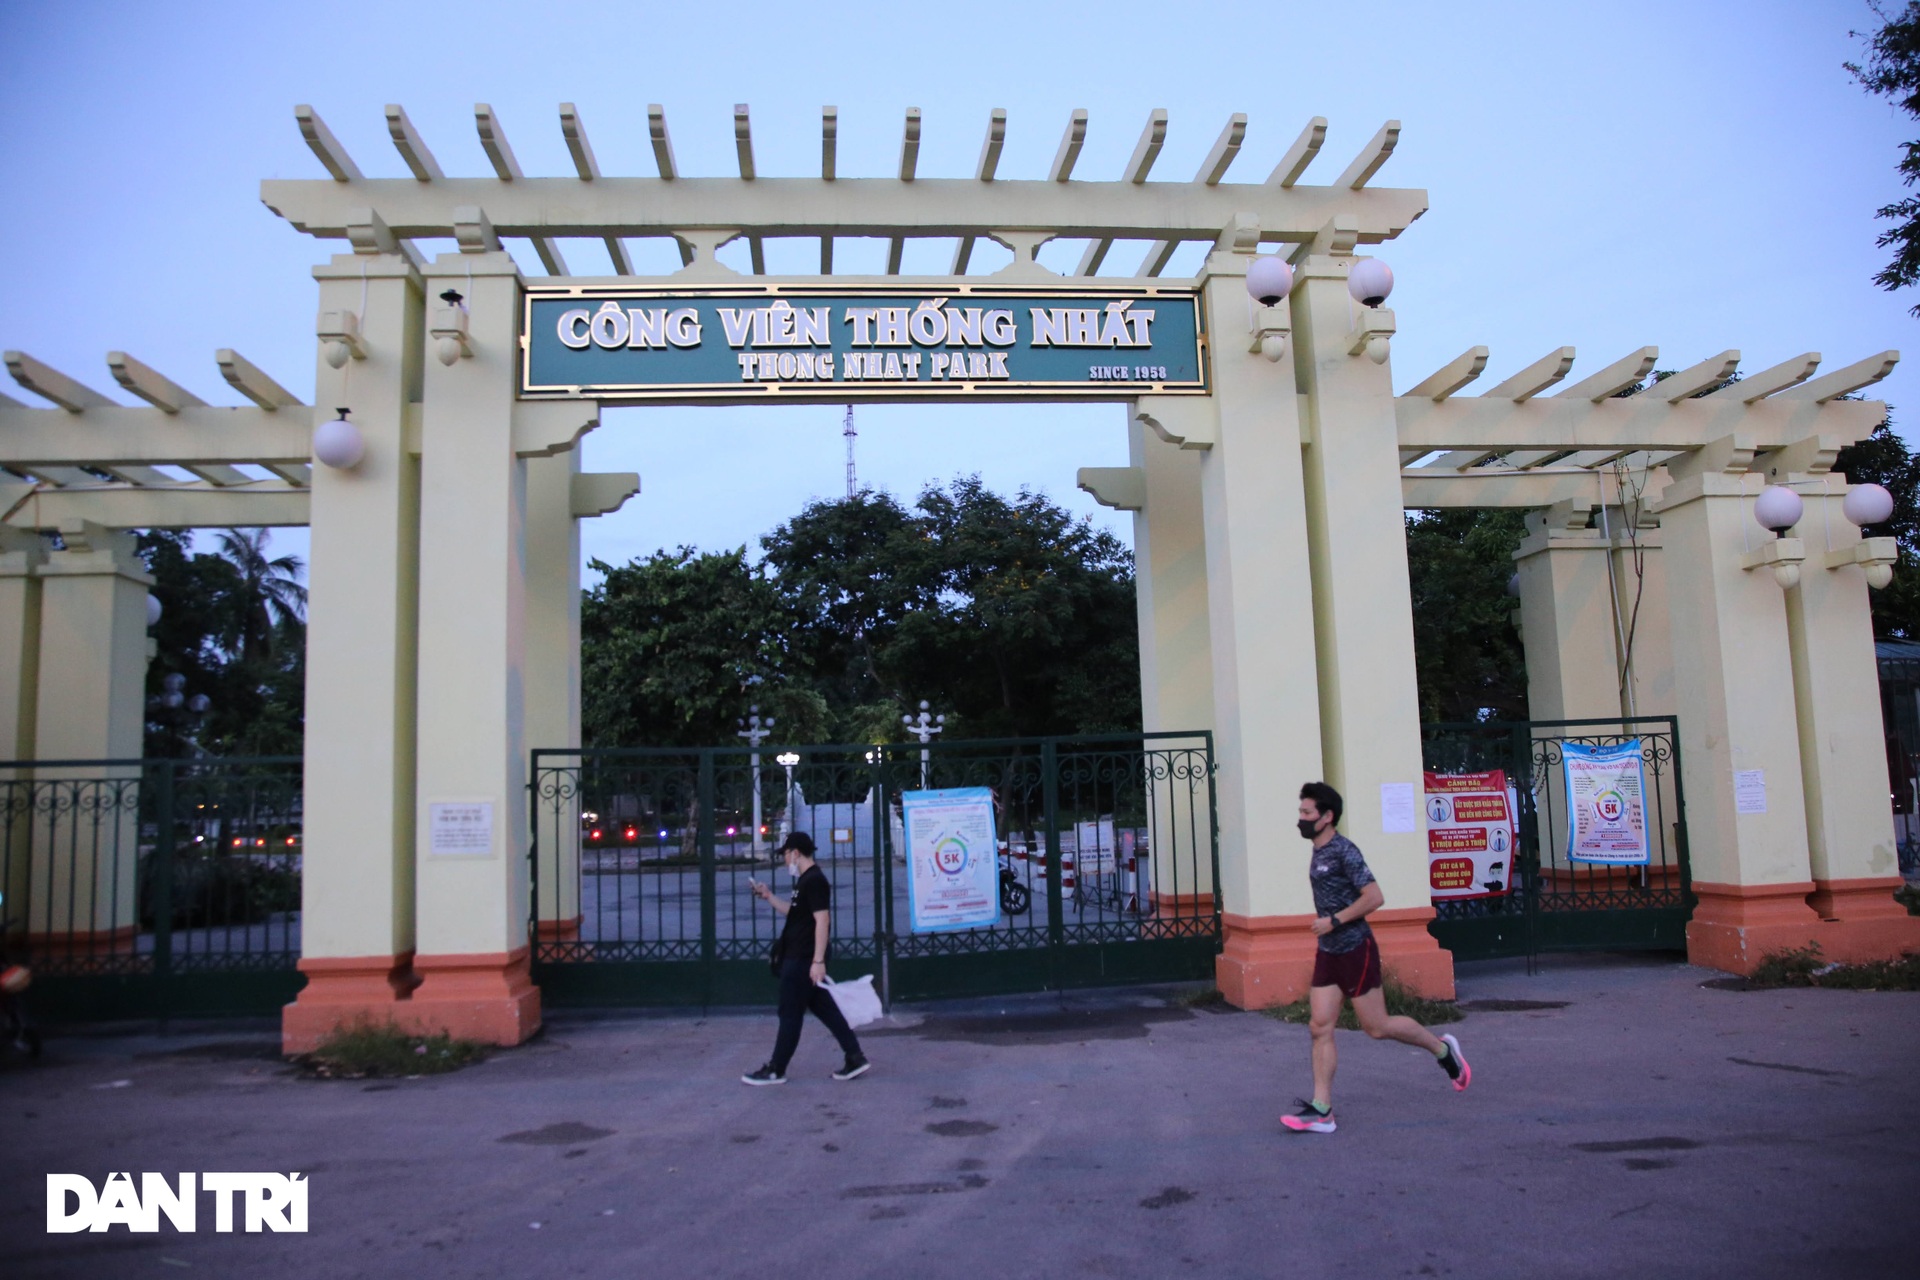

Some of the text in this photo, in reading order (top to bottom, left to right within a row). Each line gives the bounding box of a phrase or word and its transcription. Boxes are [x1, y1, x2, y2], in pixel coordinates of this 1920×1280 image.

[557, 298, 1155, 348] CÔNG VIÊN THỐNG NHẤT
[738, 352, 1009, 379] THONG NHAT PARK
[1090, 366, 1166, 380] SINCE 1958
[1605, 803, 1617, 814] 5K
[944, 853, 960, 865] 5K
